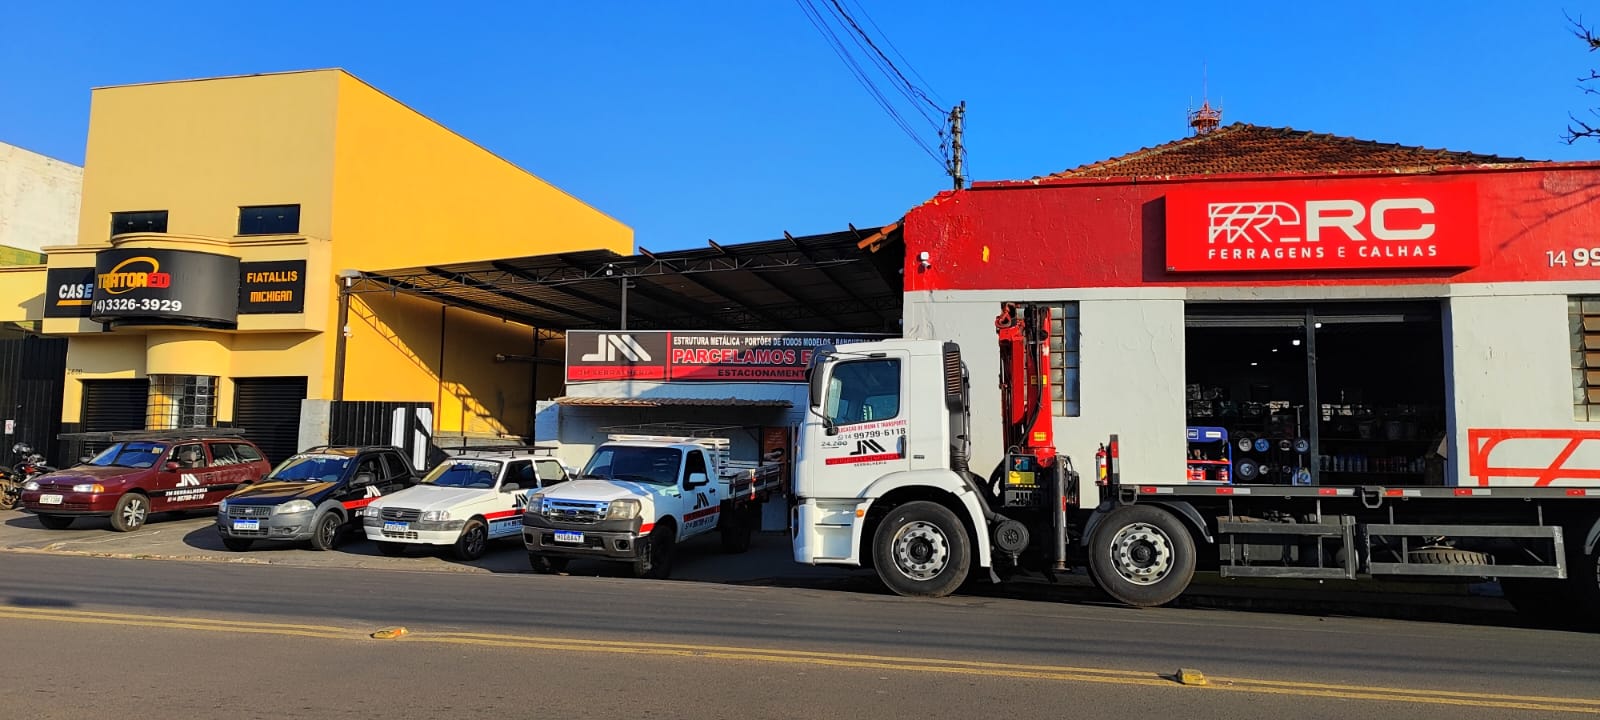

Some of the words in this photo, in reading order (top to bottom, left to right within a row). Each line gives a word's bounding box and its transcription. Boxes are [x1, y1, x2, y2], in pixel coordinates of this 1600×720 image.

[1305, 198, 1436, 242] RC
[1208, 246, 1325, 260] FERRAGENS
[1337, 246, 1346, 258] E
[1358, 245, 1437, 258] CALHAS
[1546, 250, 1568, 267] 14
[246, 271, 298, 283] FIATALLIS
[58, 283, 94, 299] CASE
[249, 290, 293, 303] MICHIGAN
[673, 336, 709, 345] ESTRUTURA
[710, 335, 740, 346] METÁLICA
[744, 335, 772, 346] PORTÕES
[773, 337, 782, 346] DE
[783, 337, 802, 346] TODOS
[803, 337, 831, 346] MODELOS
[672, 348, 796, 365] PARCELAMOS
[717, 368, 806, 377] ESTACIONAMENT
[853, 428, 906, 440] 99799-6118
